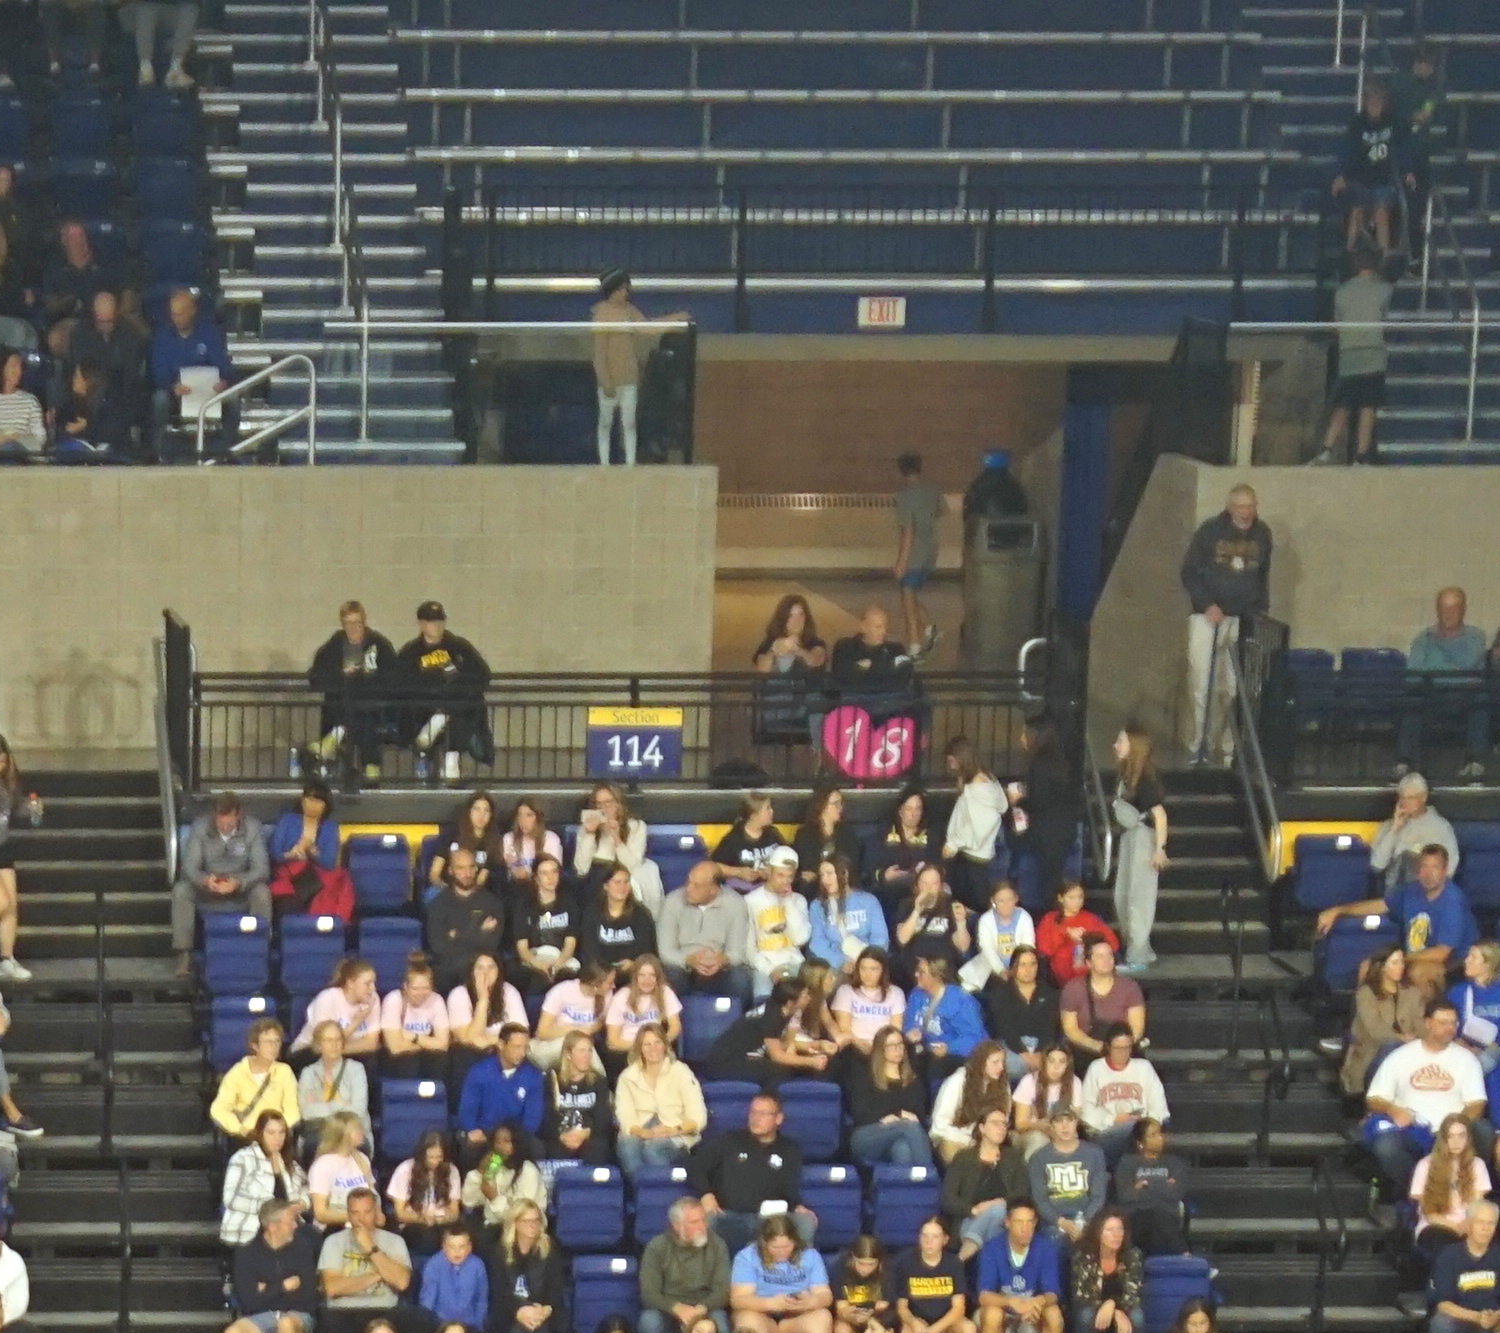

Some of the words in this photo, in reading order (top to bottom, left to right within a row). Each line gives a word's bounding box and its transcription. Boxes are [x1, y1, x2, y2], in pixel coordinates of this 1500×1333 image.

[869, 300, 897, 322] EXIT
[613, 711, 660, 724] Section
[608, 735, 664, 768] 114
[1046, 1160, 1089, 1193] MU
